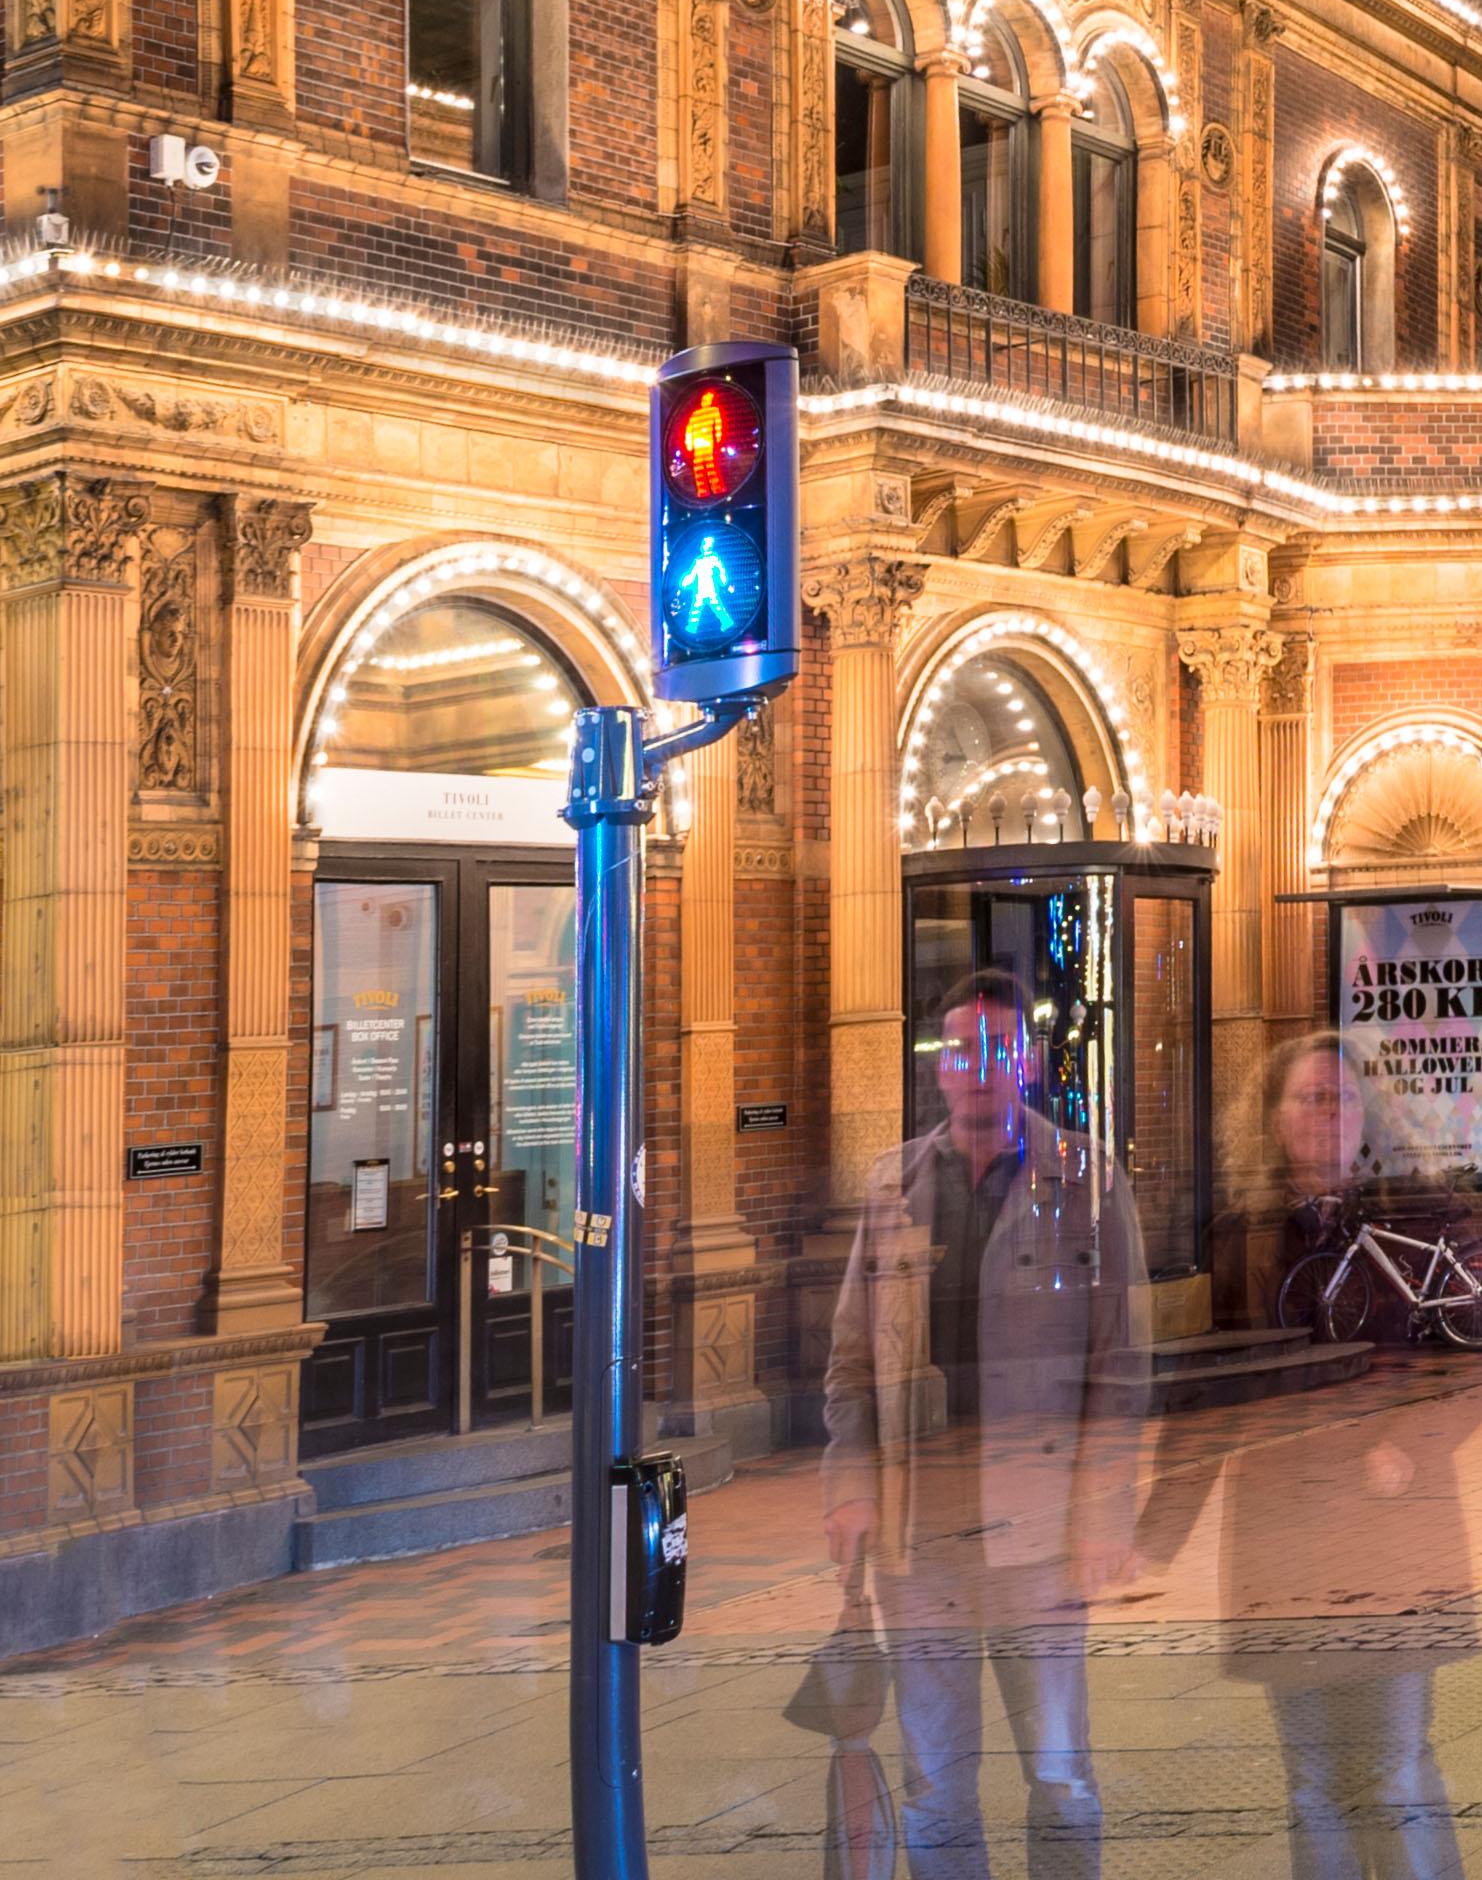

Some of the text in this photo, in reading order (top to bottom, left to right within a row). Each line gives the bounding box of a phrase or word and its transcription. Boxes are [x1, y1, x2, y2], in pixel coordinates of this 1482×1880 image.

[443, 791, 489, 806] TIVOLI
[1409, 909, 1455, 925] TIVOLI
[352, 991, 399, 1009] TIVOLI
[1351, 988, 1427, 1023] 280
[351, 1030, 400, 1042] BOX OFFICE
[1393, 1076, 1474, 1096] OG JUL
